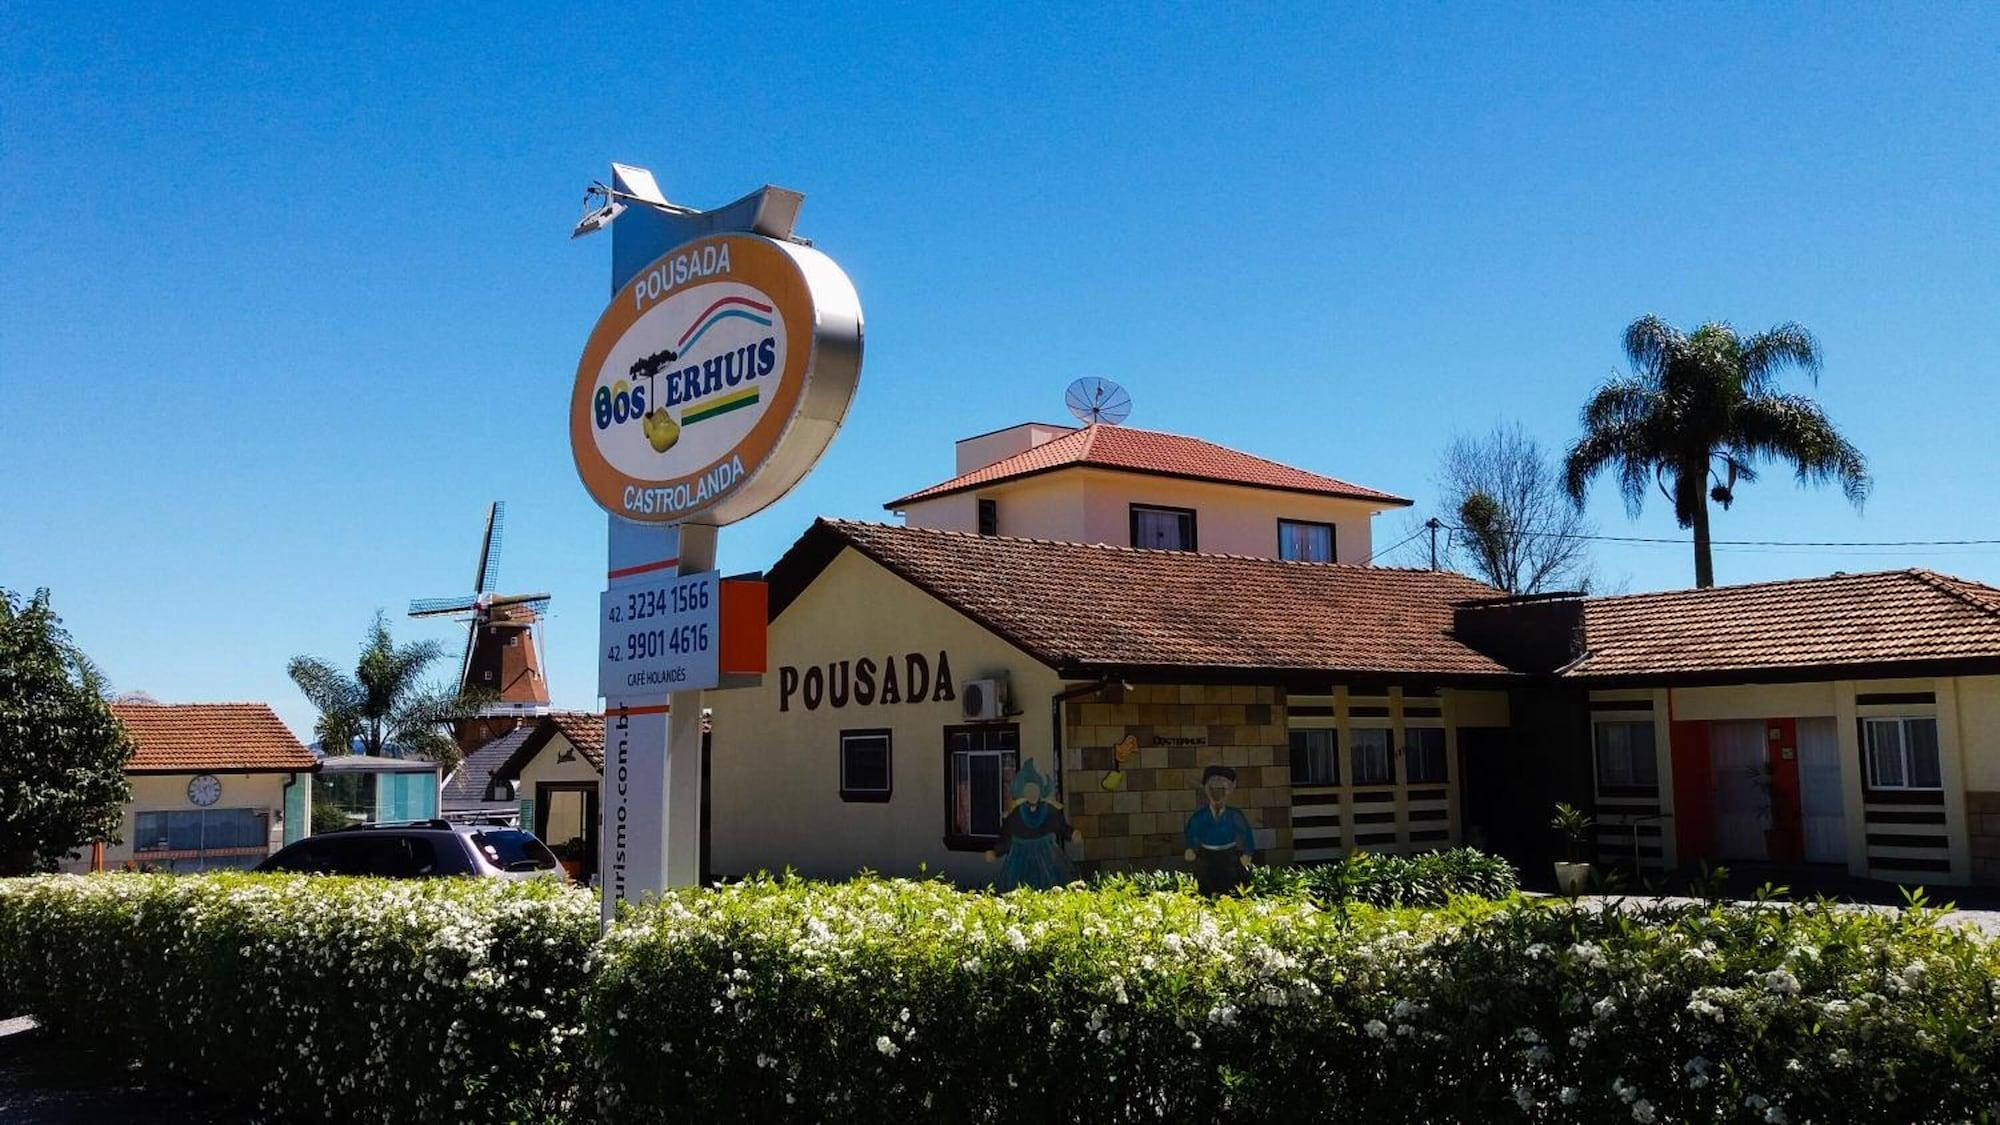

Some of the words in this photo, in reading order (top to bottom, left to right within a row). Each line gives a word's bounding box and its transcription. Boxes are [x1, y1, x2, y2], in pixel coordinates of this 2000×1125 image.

[634, 243, 731, 311] POUSADA
[623, 458, 745, 514] CASTROLANDA
[627, 588, 667, 621] 3234
[671, 580, 709, 613] 1566
[627, 629, 665, 661] 9901
[669, 623, 709, 655] 4616
[627, 669, 646, 687] CAFÉ
[778, 650, 957, 712] POUSADA
